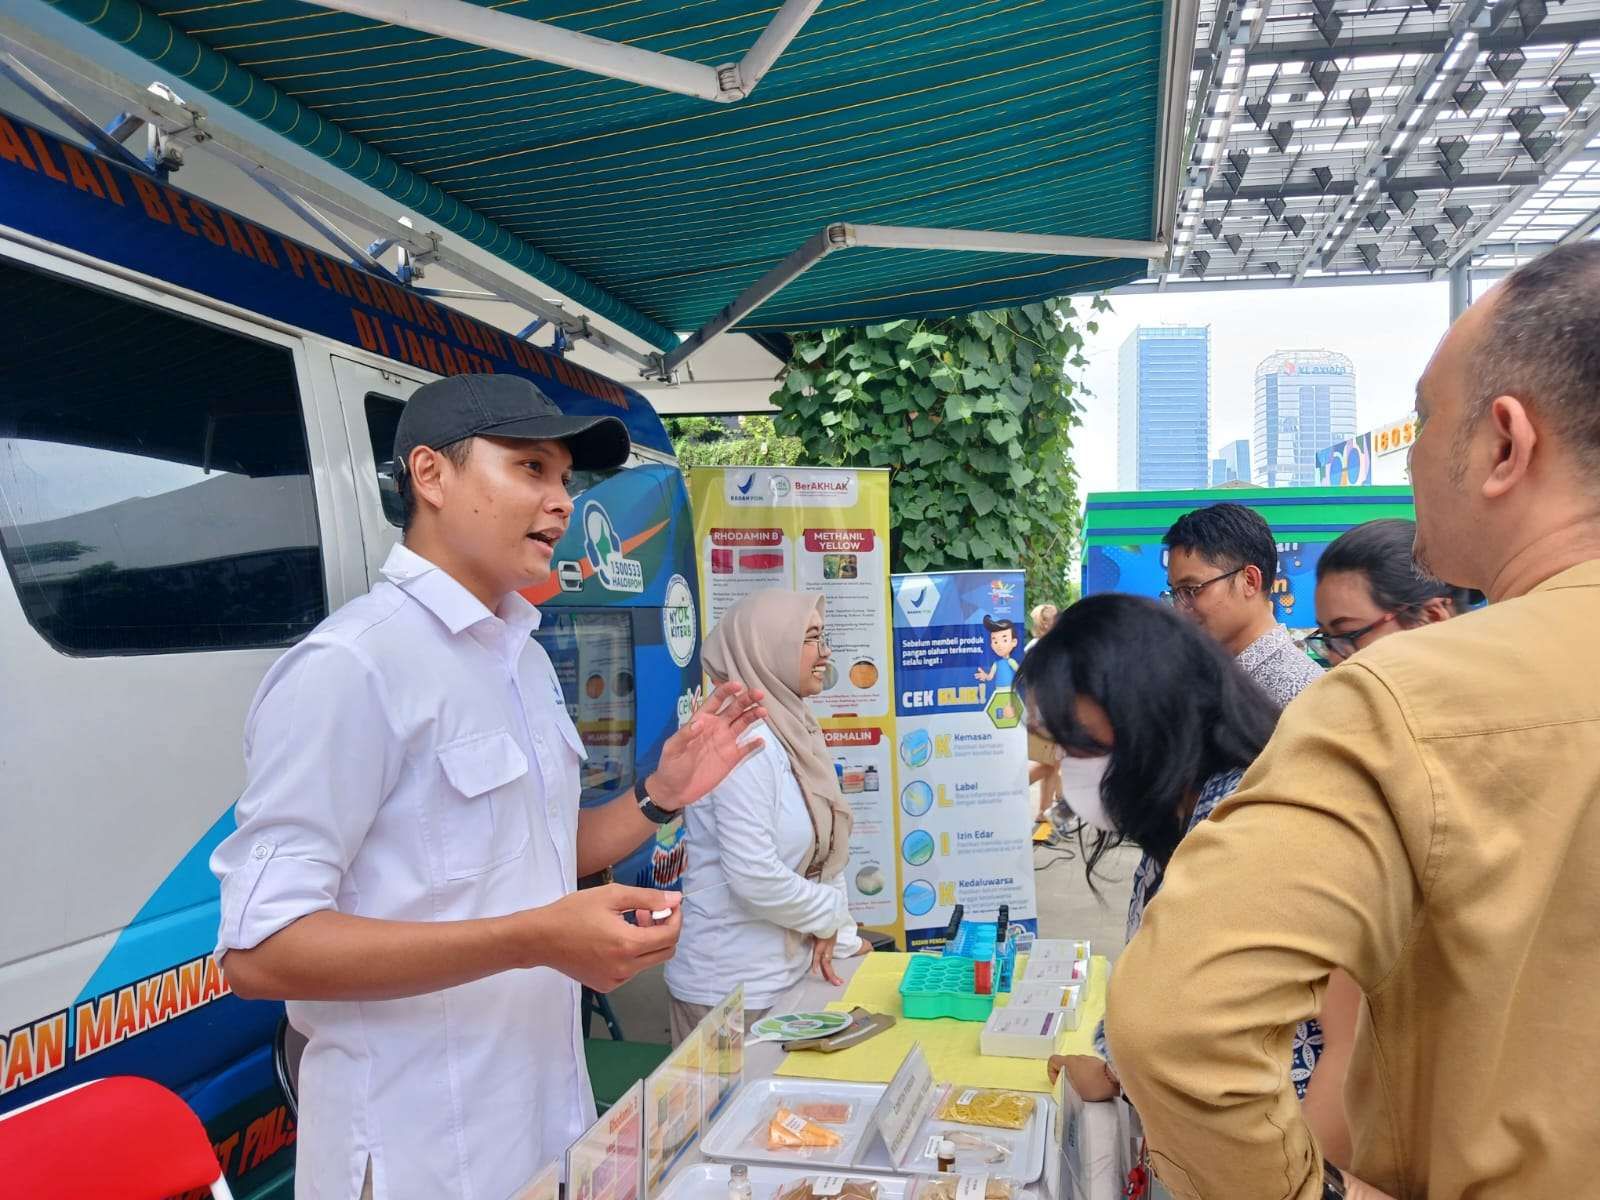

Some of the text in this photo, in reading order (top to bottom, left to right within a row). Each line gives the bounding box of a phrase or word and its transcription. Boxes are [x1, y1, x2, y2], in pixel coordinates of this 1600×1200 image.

[128, 170, 279, 269] BESAR
[352, 306, 389, 358] DI
[795, 481, 848, 491] BerAKHLAK
[714, 531, 779, 541] RHODAMIN B
[814, 532, 865, 541] METHANIL
[819, 542, 861, 550] YELLOW
[611, 561, 640, 577] 1500533
[902, 636, 985, 648] Sebelum membeli produk
[902, 650, 927, 658] pangan
[902, 658, 923, 667] selalu
[902, 690, 935, 708] CEK
[823, 731, 872, 741] ORMALIN
[954, 733, 993, 742] Kemasan
[937, 784, 953, 808] L
[955, 782, 978, 792] Label
[957, 832, 973, 840] Izin
[974, 830, 994, 839] Edar
[959, 878, 1014, 887] Kedaluwarsa
[0, 1012, 67, 1092] AN
